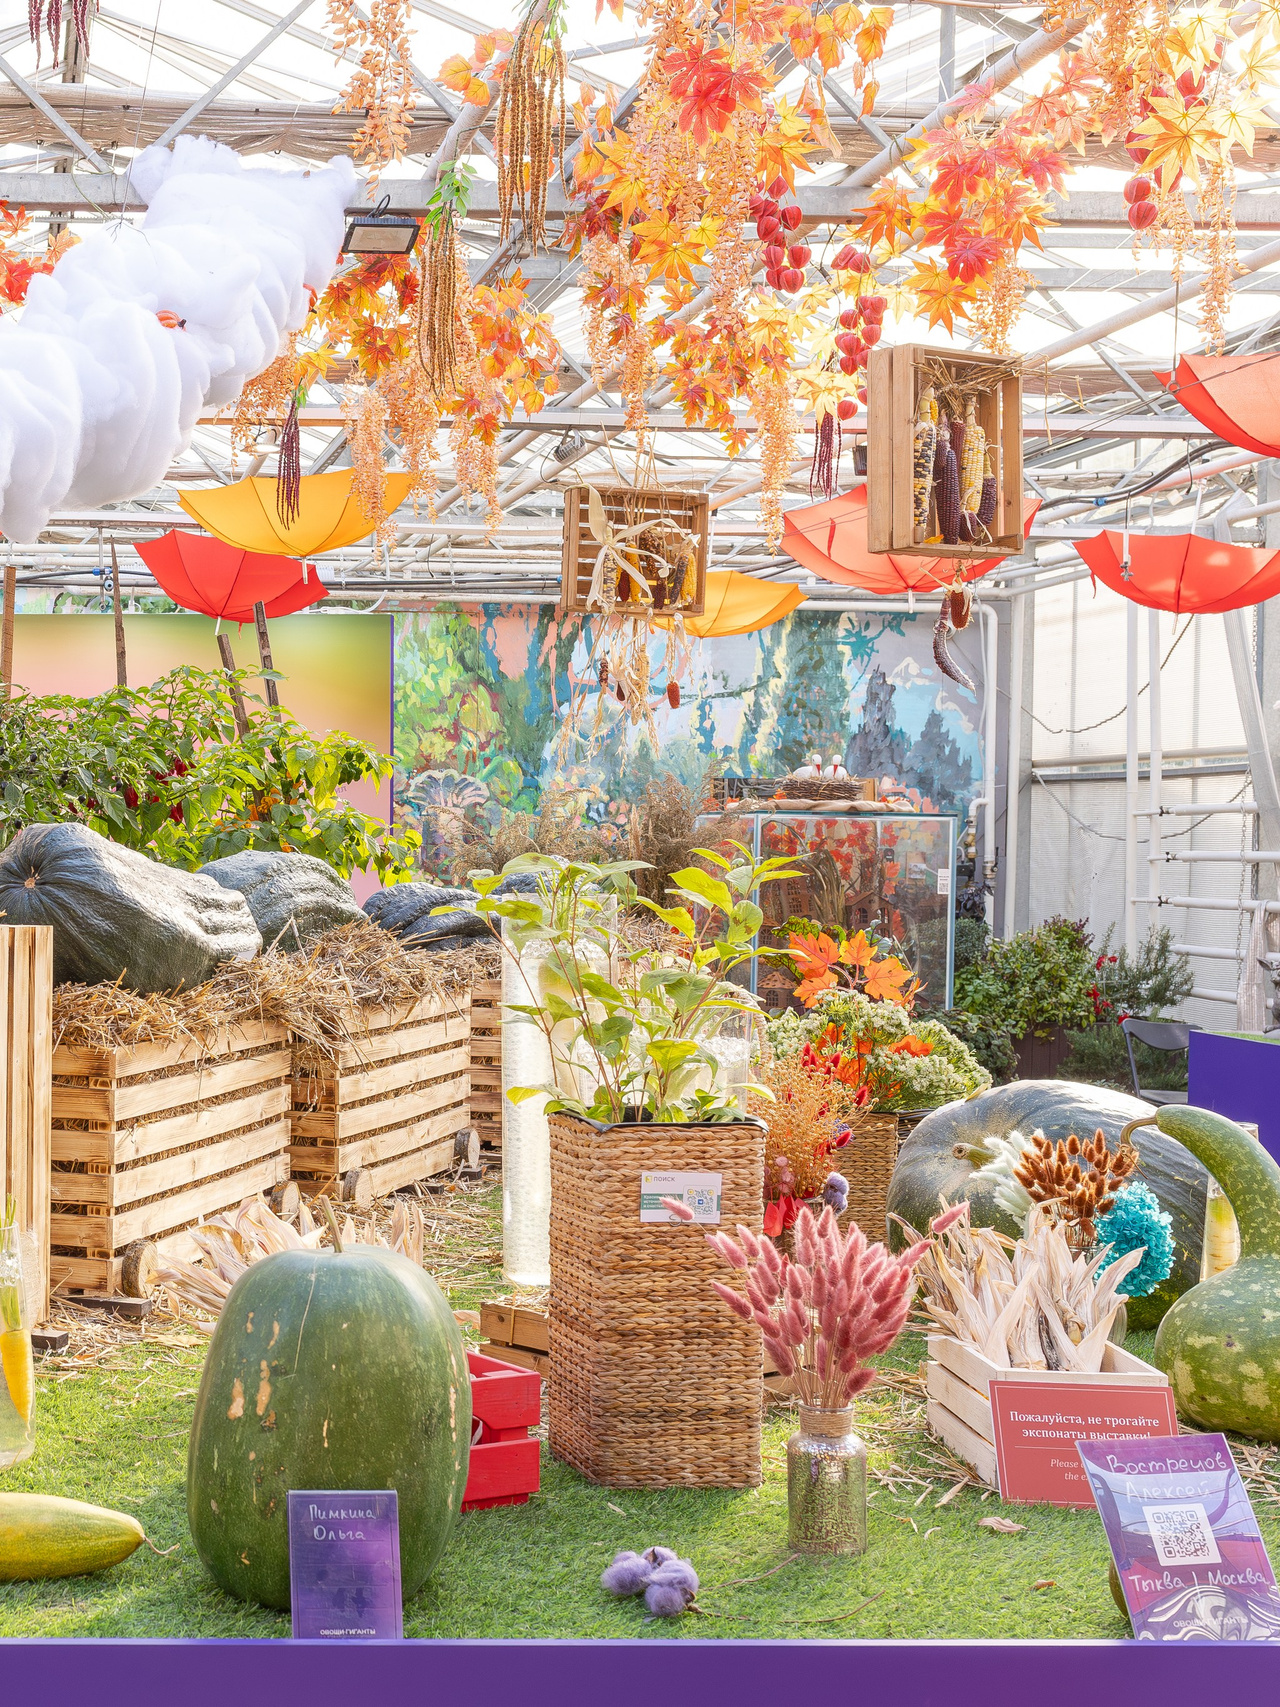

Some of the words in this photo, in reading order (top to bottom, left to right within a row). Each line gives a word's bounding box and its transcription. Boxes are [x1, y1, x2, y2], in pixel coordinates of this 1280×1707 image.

[1010, 1411, 1085, 1425] Пожалуйста,
[1087, 1415, 1102, 1425] не
[1104, 1416, 1160, 1428] трогайте
[1022, 1428, 1087, 1440] экспонаты
[1050, 1458, 1079, 1468] Please
[1105, 1451, 1227, 1479] Вострецов
[1064, 1471, 1079, 1480] the
[1126, 1480, 1211, 1503] Алексей
[313, 1525, 366, 1540] Ольга
[1128, 1571, 1188, 1592] Тыква
[1208, 1568, 1270, 1587] Москва
[320, 1628, 376, 1636] ОВОЩИ-ГИГАНТЫ
